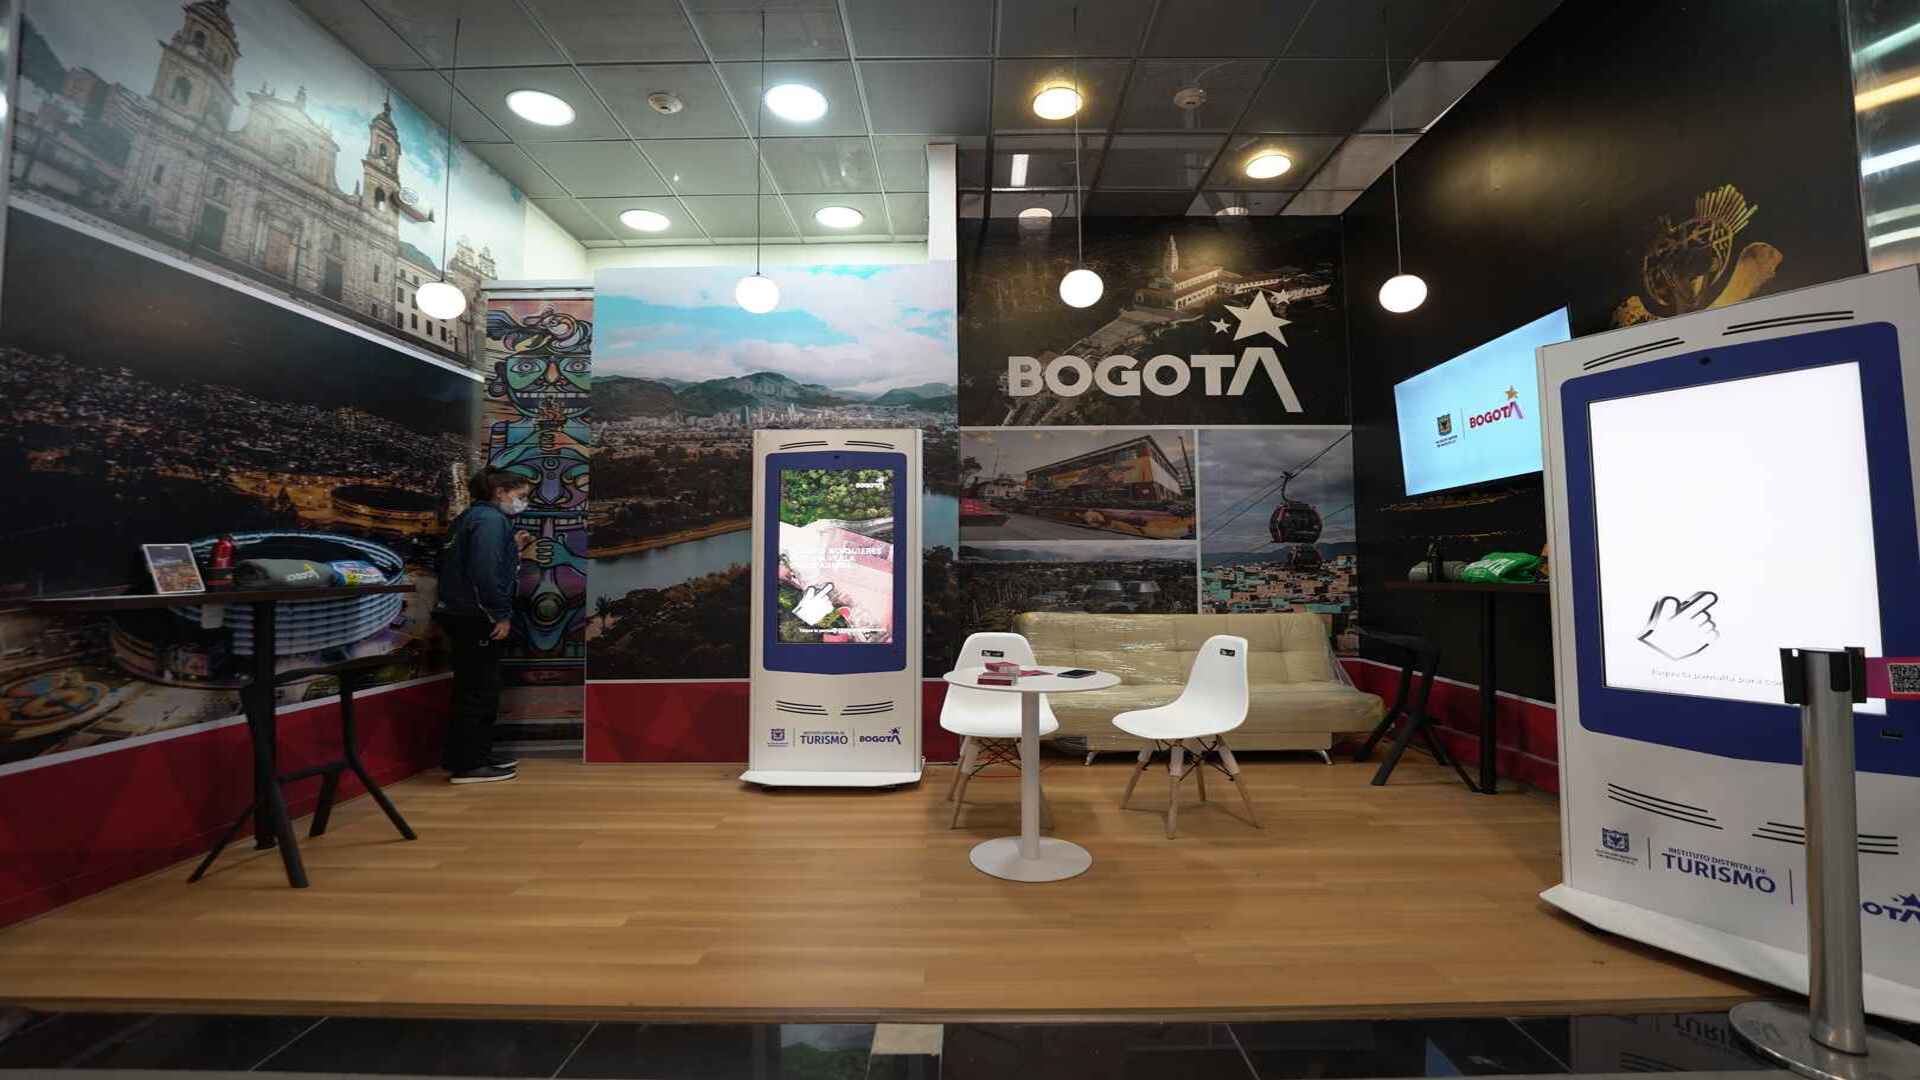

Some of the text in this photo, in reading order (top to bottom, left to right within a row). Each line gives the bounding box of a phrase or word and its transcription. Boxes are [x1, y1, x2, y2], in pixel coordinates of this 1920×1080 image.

[800, 735, 848, 745] TURISMO
[1668, 847, 1710, 862] INSTITUTO
[1711, 856, 1753, 872] DISTRITAL
[1661, 852, 1776, 893] TURISMO
